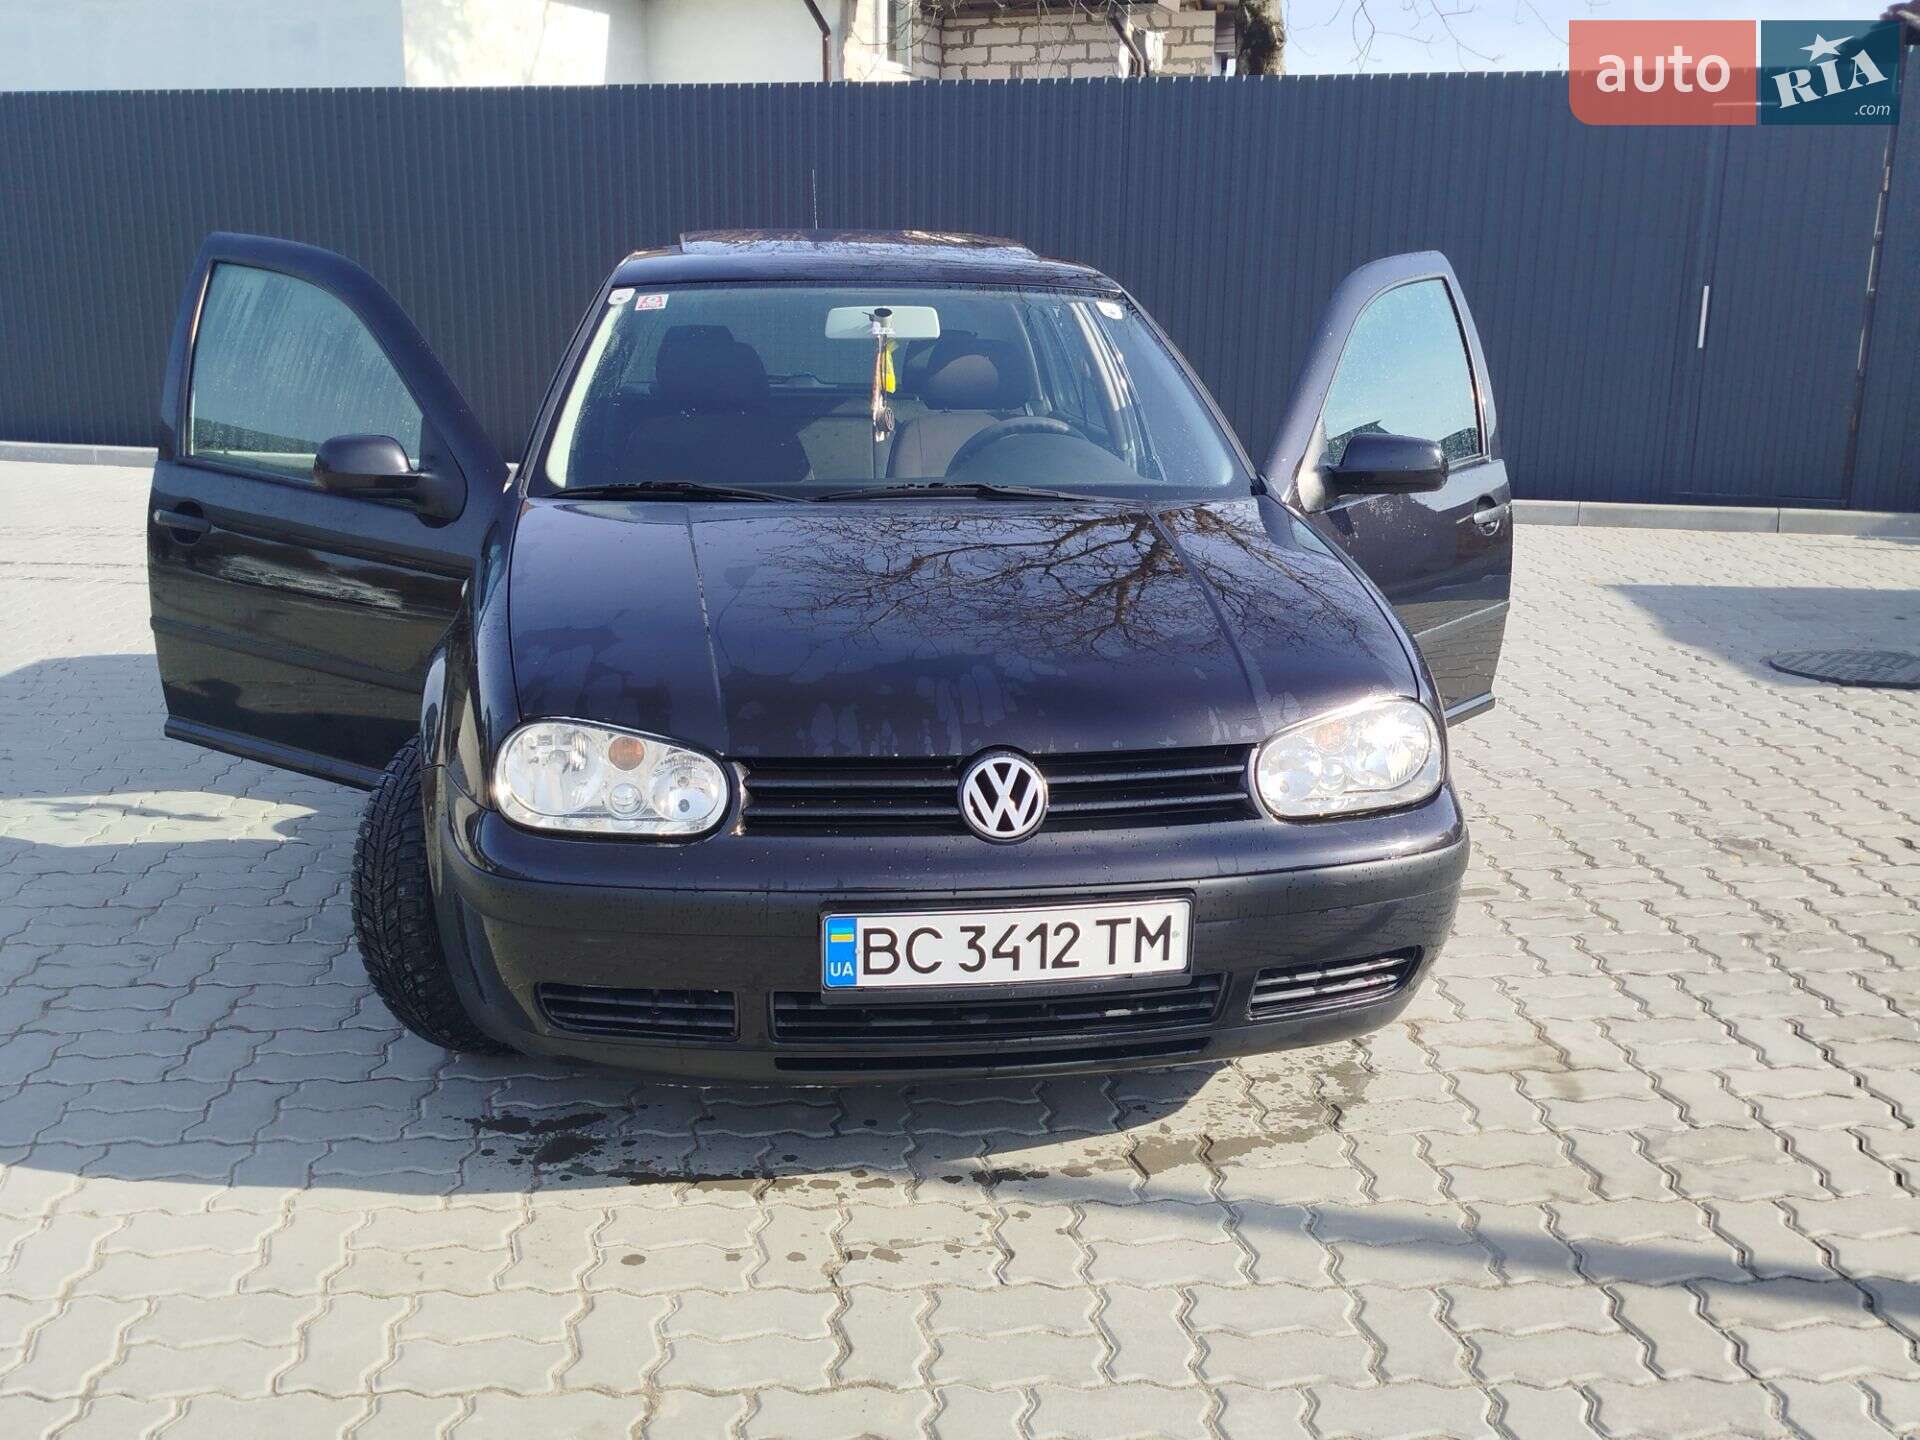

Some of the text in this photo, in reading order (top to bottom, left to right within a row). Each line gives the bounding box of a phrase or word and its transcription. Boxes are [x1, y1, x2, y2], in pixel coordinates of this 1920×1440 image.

[963, 757, 1043, 838] VW
[830, 962, 854, 977] UA
[862, 915, 1172, 975] BC 3412 TM
